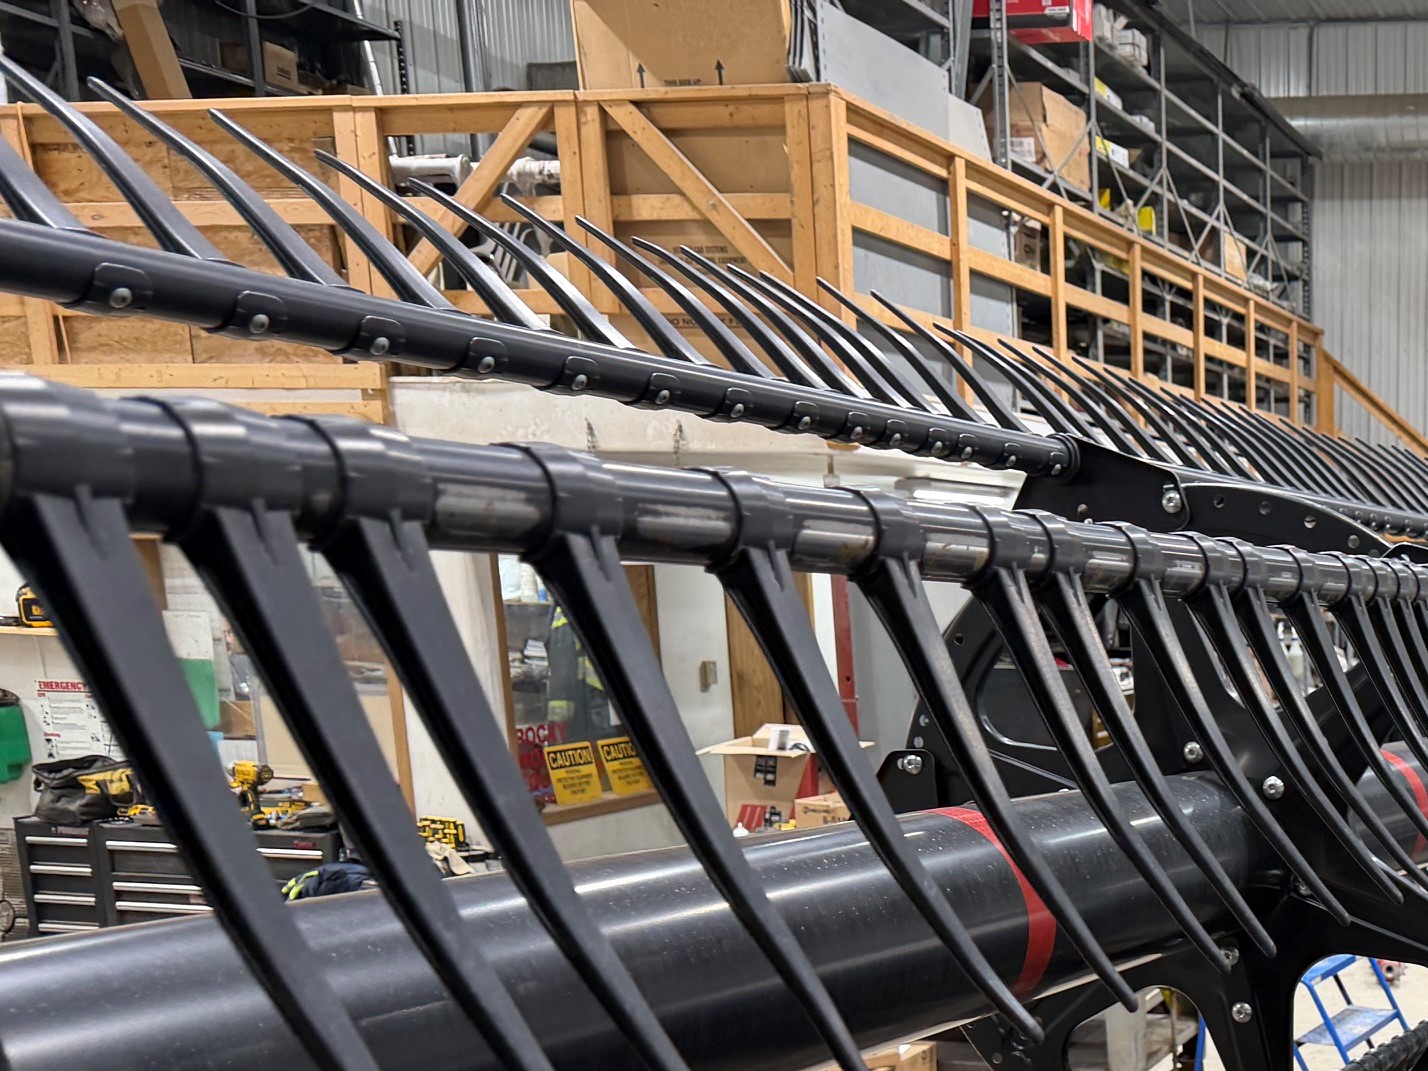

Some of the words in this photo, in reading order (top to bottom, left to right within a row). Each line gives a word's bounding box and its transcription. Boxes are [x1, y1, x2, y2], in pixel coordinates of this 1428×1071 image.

[38, 681, 88, 691] EMERGENCY
[549, 748, 593, 768] CAUTION
[603, 743, 637, 760] CAUTIO
